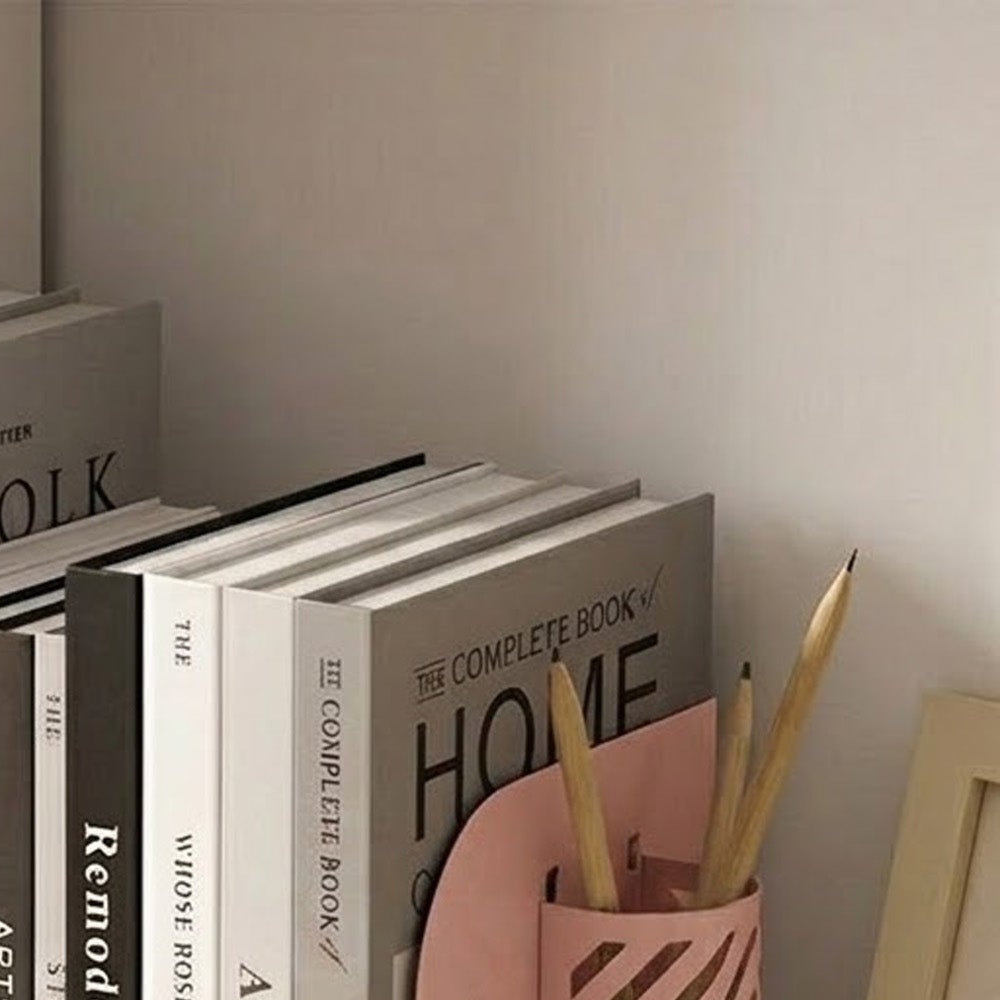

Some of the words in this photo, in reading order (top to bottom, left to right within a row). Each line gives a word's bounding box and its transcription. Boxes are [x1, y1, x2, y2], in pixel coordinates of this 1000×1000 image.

[174, 619, 192, 668] THE
[451, 614, 570, 685] COMPLETE
[576, 587, 636, 640] BOOK
[173, 833, 194, 932] WHOSE
[319, 855, 341, 933] BOOK
